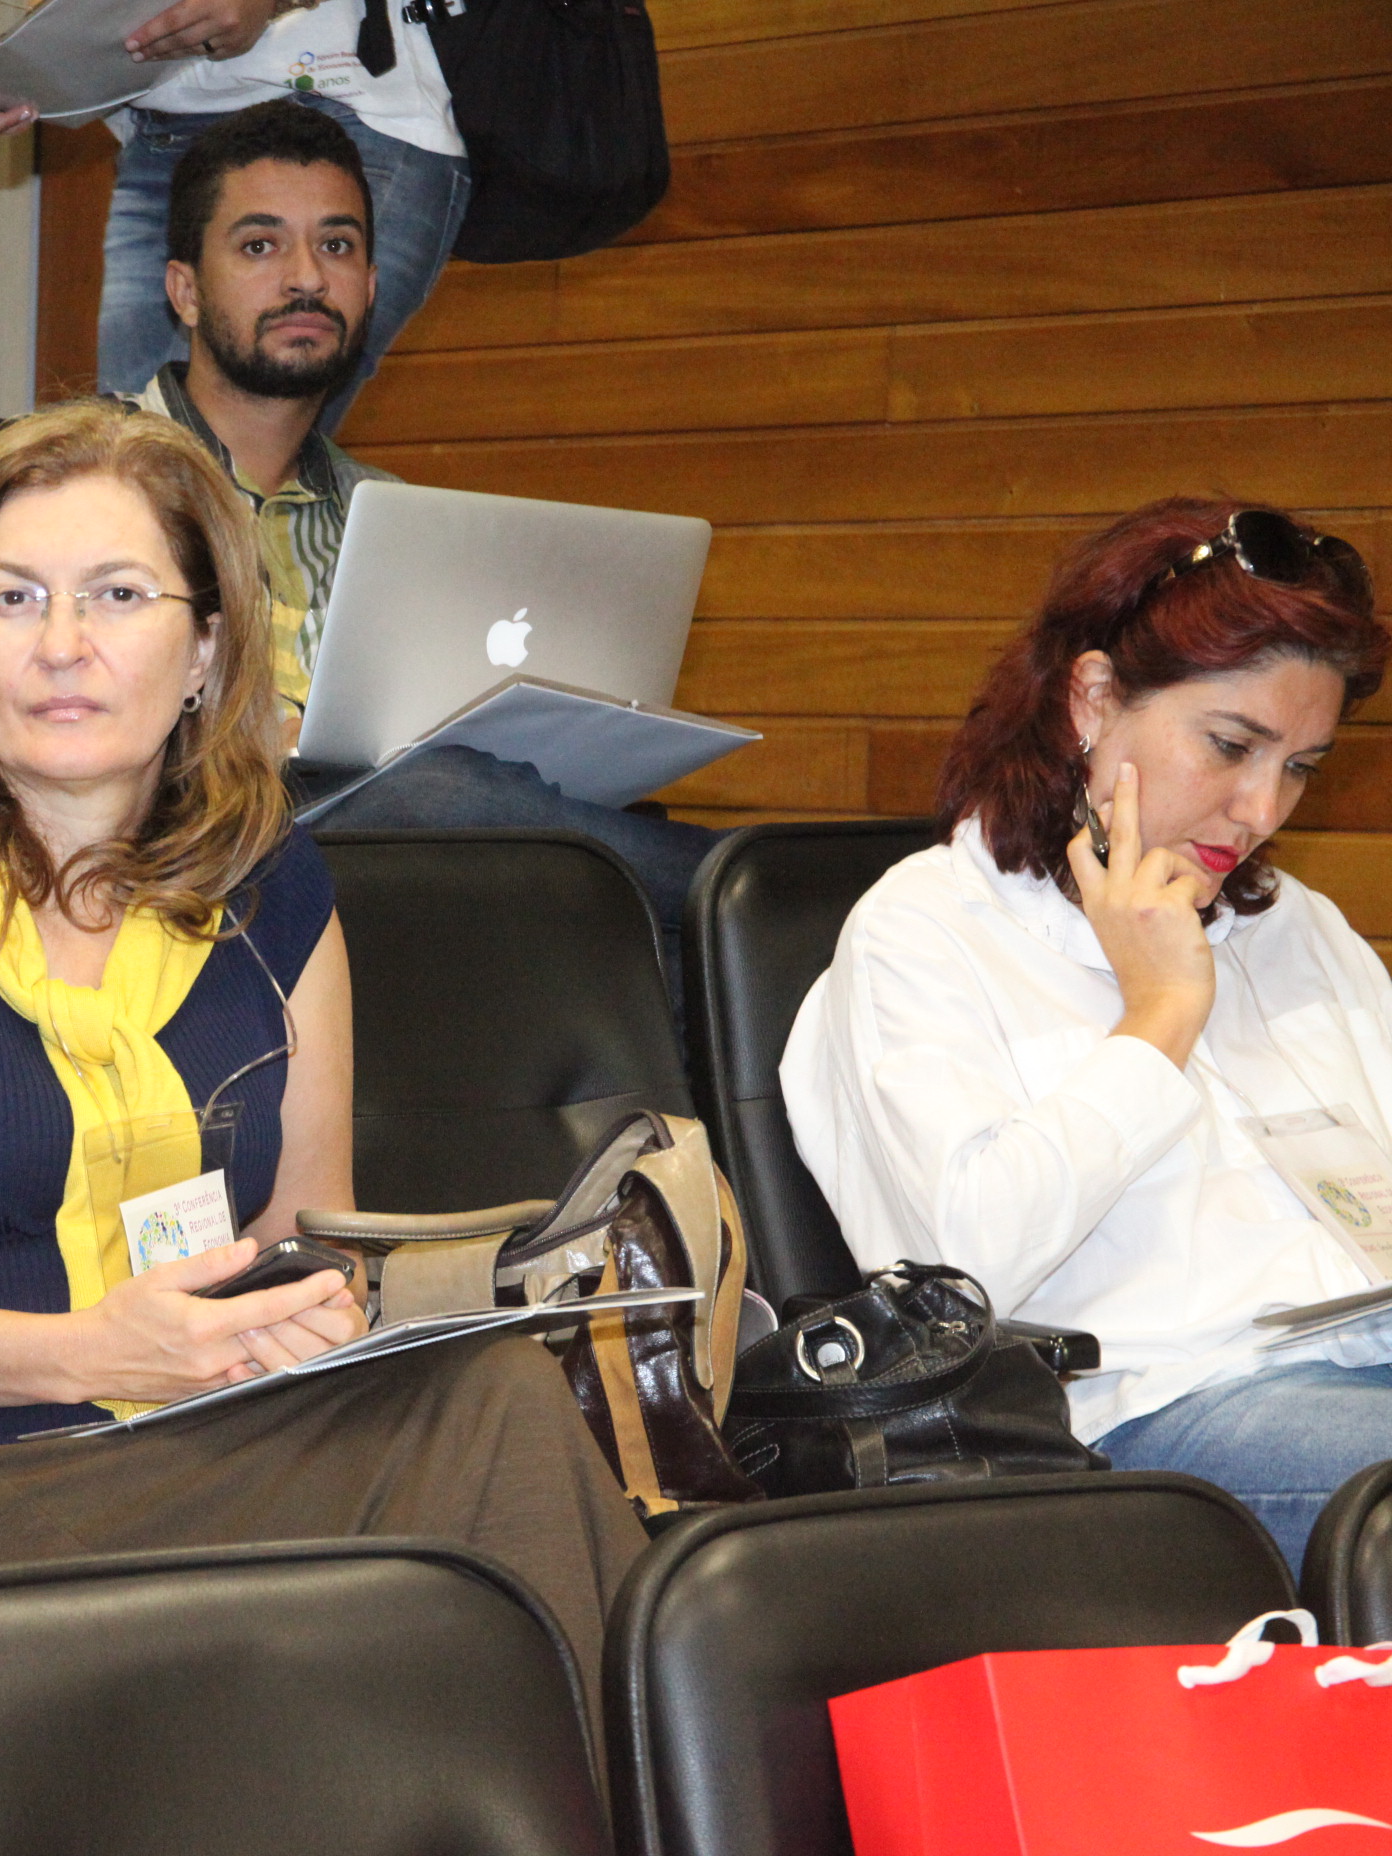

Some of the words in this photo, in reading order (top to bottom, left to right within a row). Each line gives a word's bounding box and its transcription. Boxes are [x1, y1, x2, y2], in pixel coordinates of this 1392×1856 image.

[318, 76, 350, 89] anos
[182, 1189, 223, 1213] CONFERÊNCIA
[188, 1216, 218, 1234] REGIONAL
[218, 1210, 227, 1224] DE
[203, 1233, 230, 1251] ECONOMIA
